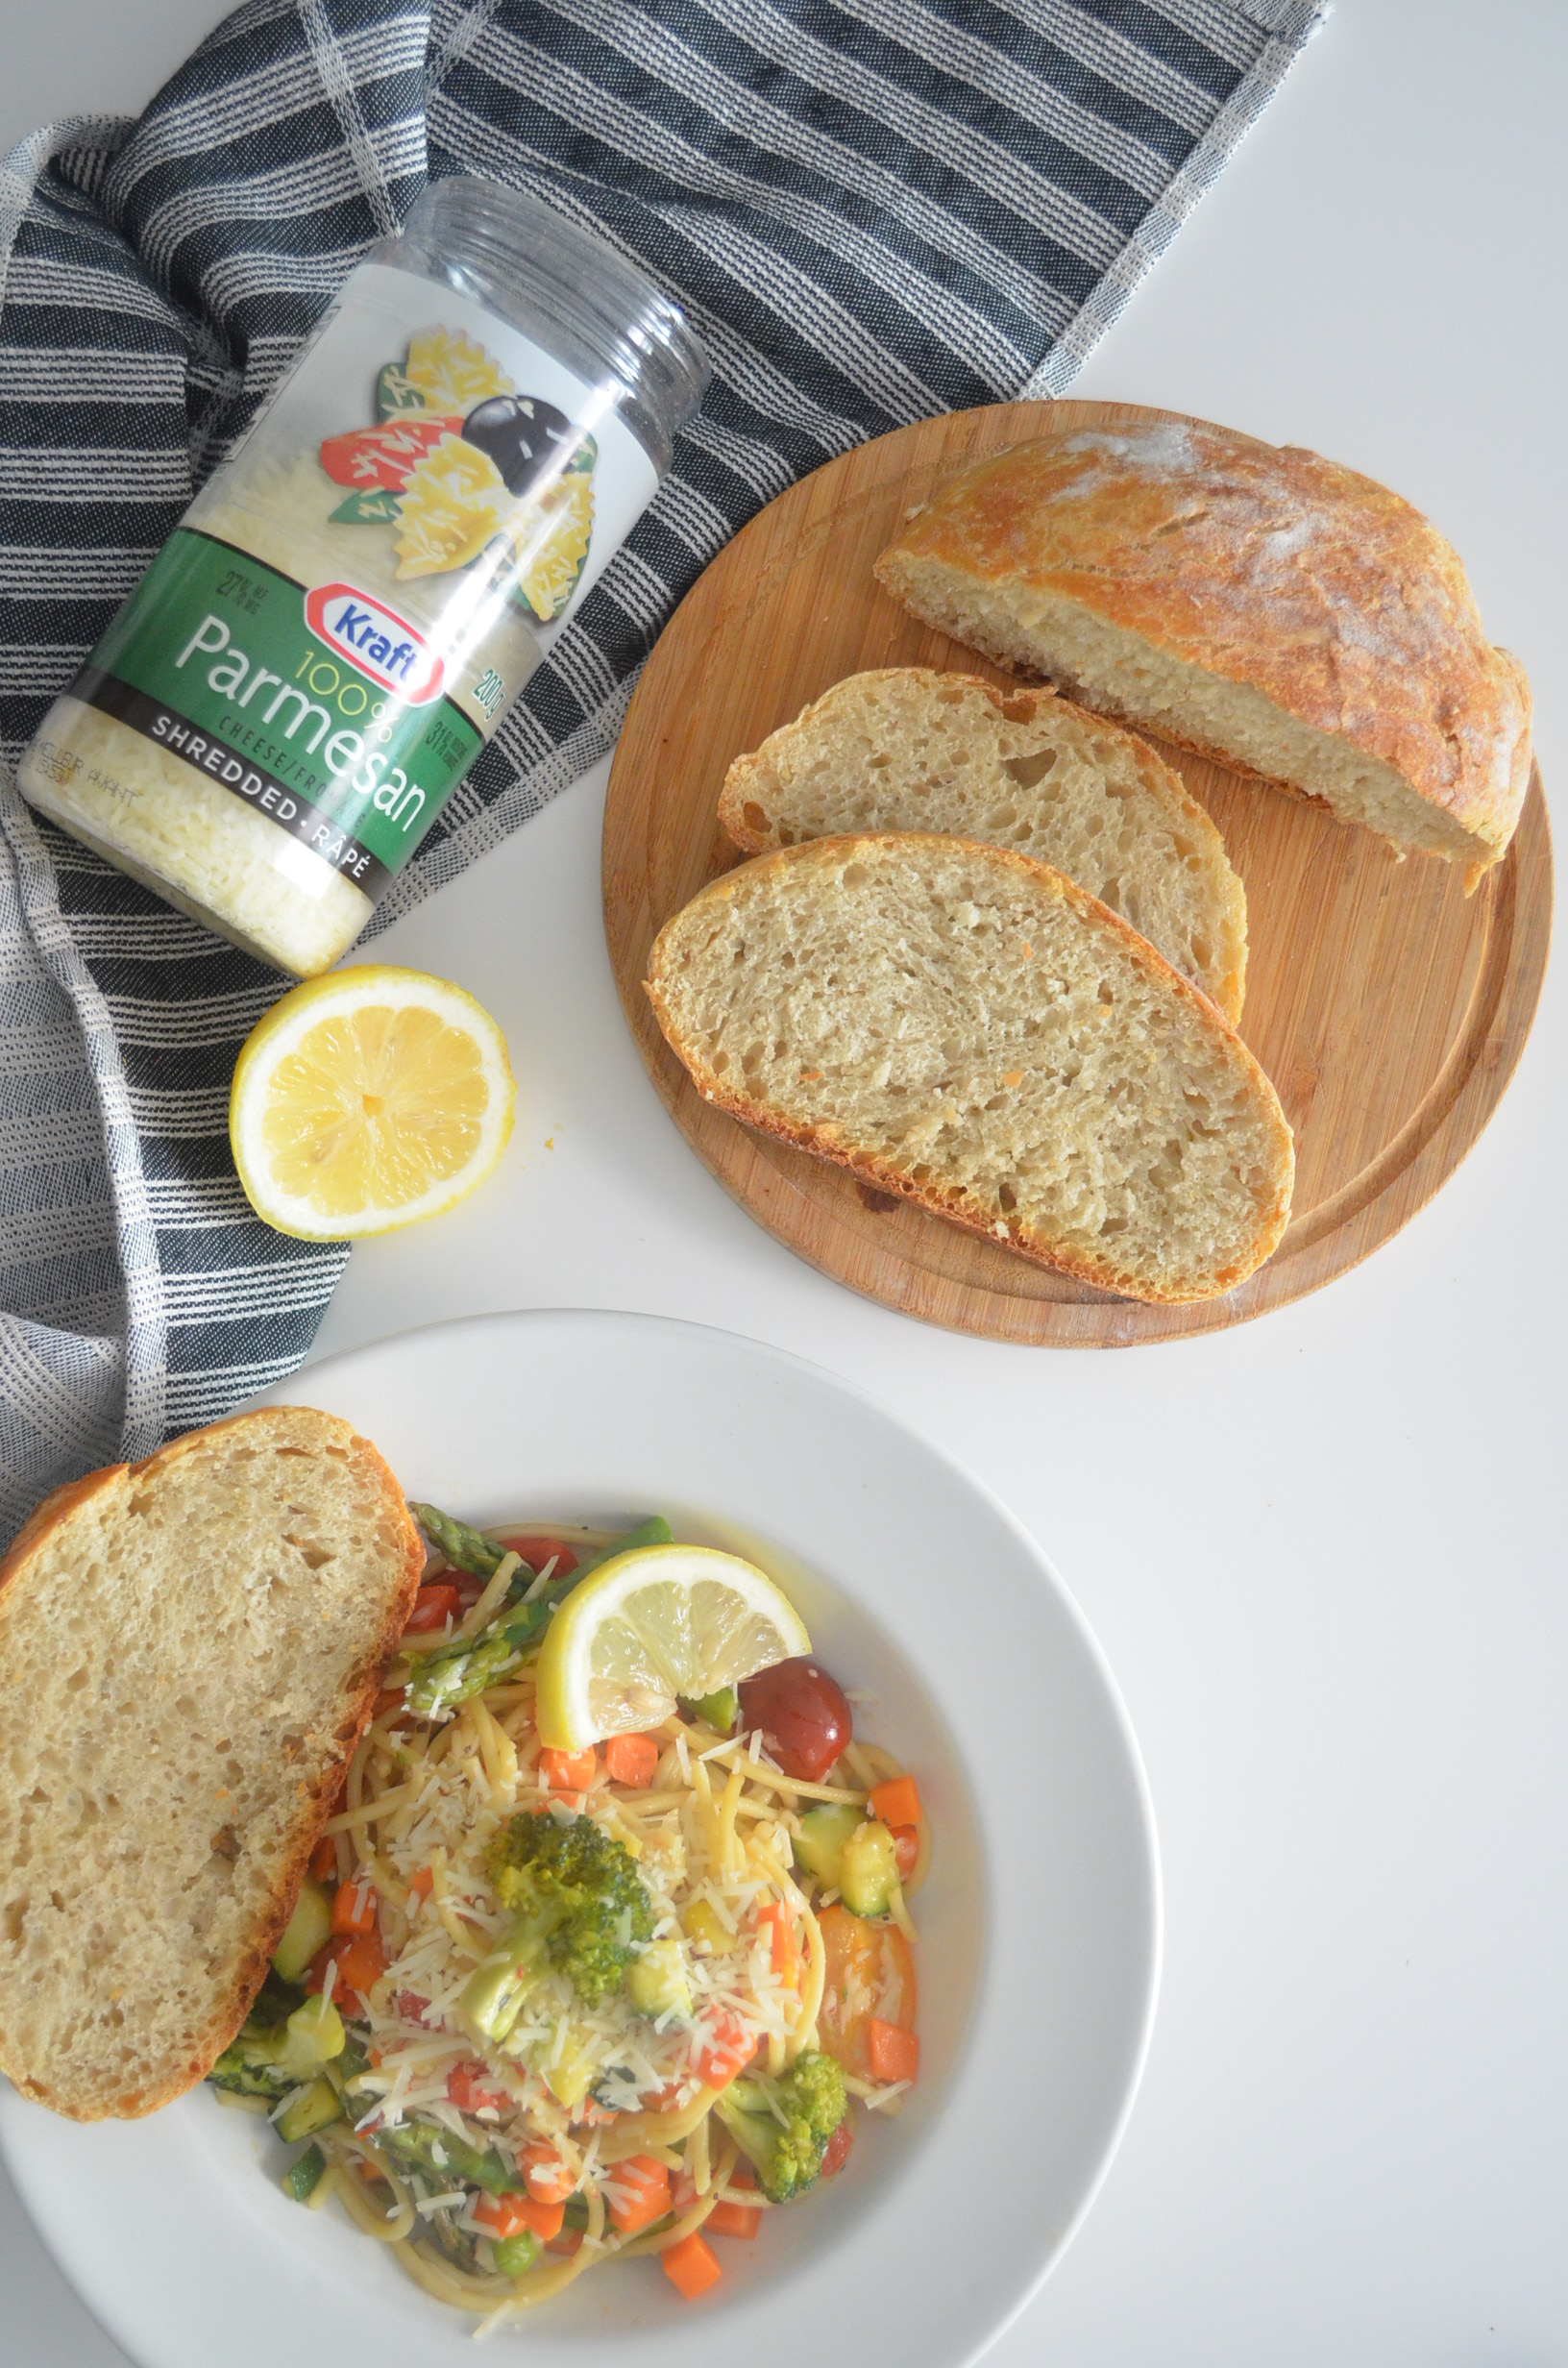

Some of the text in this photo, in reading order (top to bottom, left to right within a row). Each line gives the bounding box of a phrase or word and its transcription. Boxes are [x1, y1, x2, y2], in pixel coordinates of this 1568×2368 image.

[295, 650, 400, 743] 100%
[333, 603, 419, 683] Kraft
[175, 614, 427, 833] Parmesan
[152, 716, 298, 821] SHREDDED
[310, 824, 372, 878] RÂPÉ
